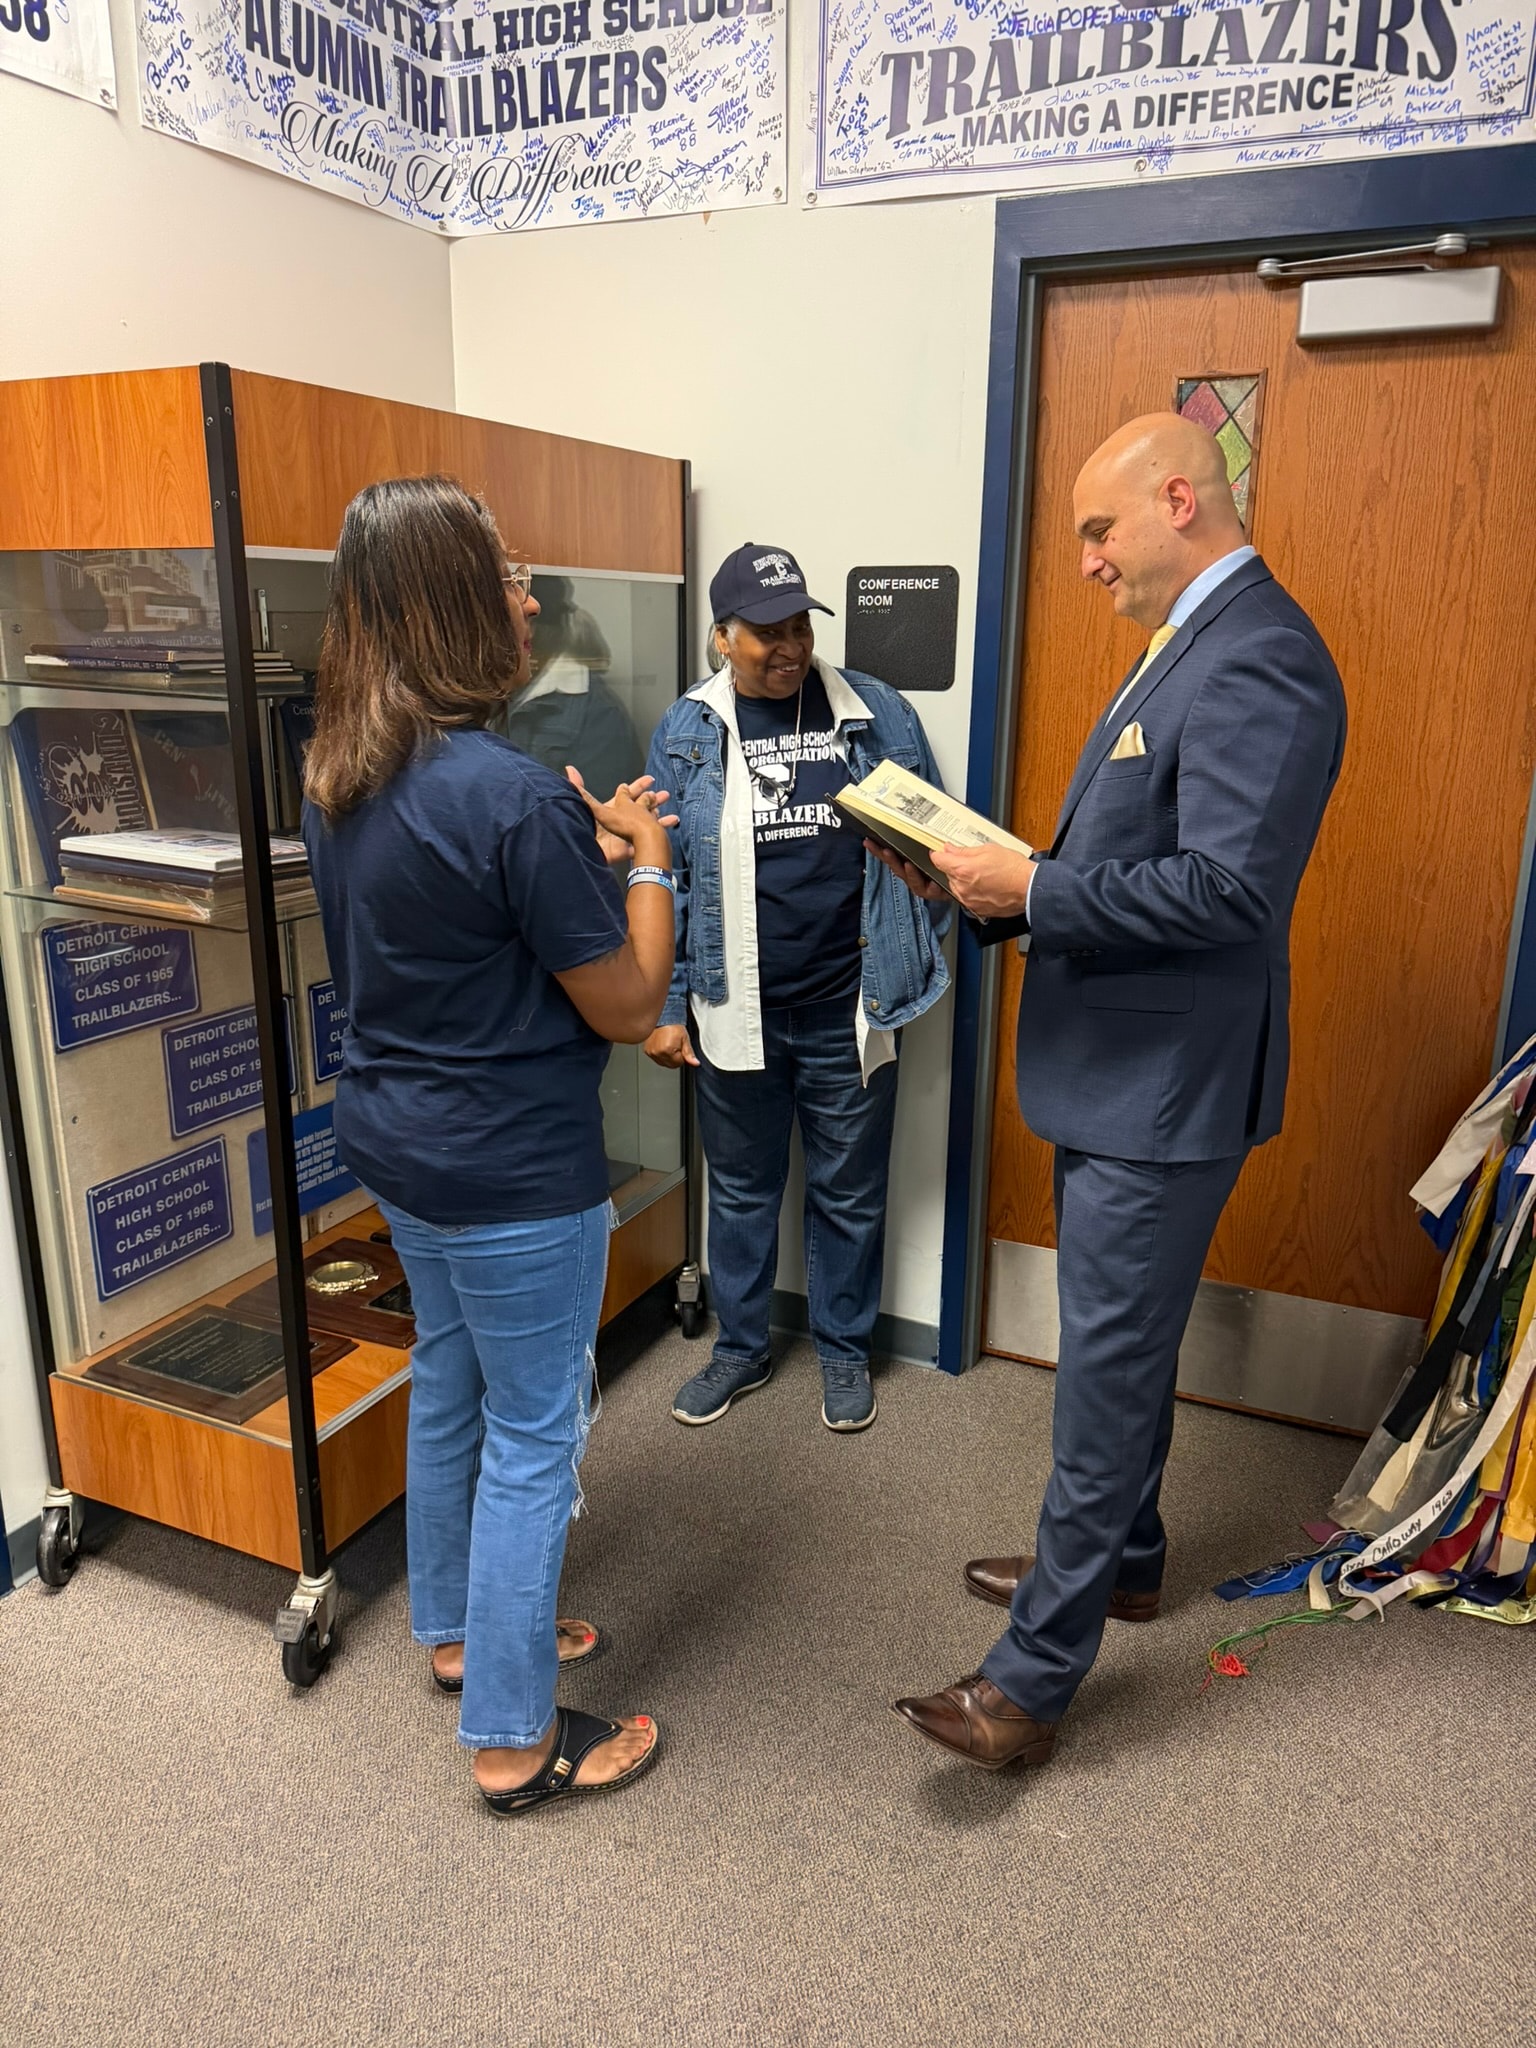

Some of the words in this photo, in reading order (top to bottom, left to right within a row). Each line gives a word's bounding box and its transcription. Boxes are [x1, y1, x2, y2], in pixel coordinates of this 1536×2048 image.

[328, 0, 485, 62] ENTRAL
[493, 1, 591, 54] HIGH
[246, 0, 387, 111] ALUMNI
[393, 45, 667, 138] TRAILBLAZERS
[880, 0, 1457, 140] TRAILBLAZERS
[962, 104, 1090, 148] MAKING
[1099, 99, 1122, 134] A
[1133, 72, 1355, 131] DIFFERENCE
[281, 101, 398, 207] Making
[470, 133, 645, 231] Difference
[857, 595, 893, 607] ROOM
[858, 578, 940, 591] CONFERENCE
[779, 733, 801, 751] HIGH
[753, 803, 842, 829] BLAZERS
[756, 831, 765, 844] A
[764, 825, 820, 842] DIFFERENCE
[55, 932, 117, 956] DETROIT
[74, 955, 111, 977] HIGH
[113, 943, 171, 968] SCHOOL
[74, 980, 121, 1003] CLASS
[123, 973, 142, 991] OF
[144, 966, 174, 984] 1965
[173, 1024, 227, 1052] DETROIT
[189, 1049, 220, 1070] HIGH
[189, 1069, 229, 1093] CLASS
[230, 1063, 247, 1078] OF
[96, 1177, 158, 1215] DETROIT
[162, 1151, 222, 1187] CENTRAL
[115, 1201, 153, 1230] HIGH
[155, 1181, 211, 1213] SCHOOL
[115, 1226, 163, 1255] CLASS
[165, 1213, 183, 1233] OF
[186, 1200, 215, 1221] 1968
[112, 1223, 222, 1280] TRAILBLAZERS...
